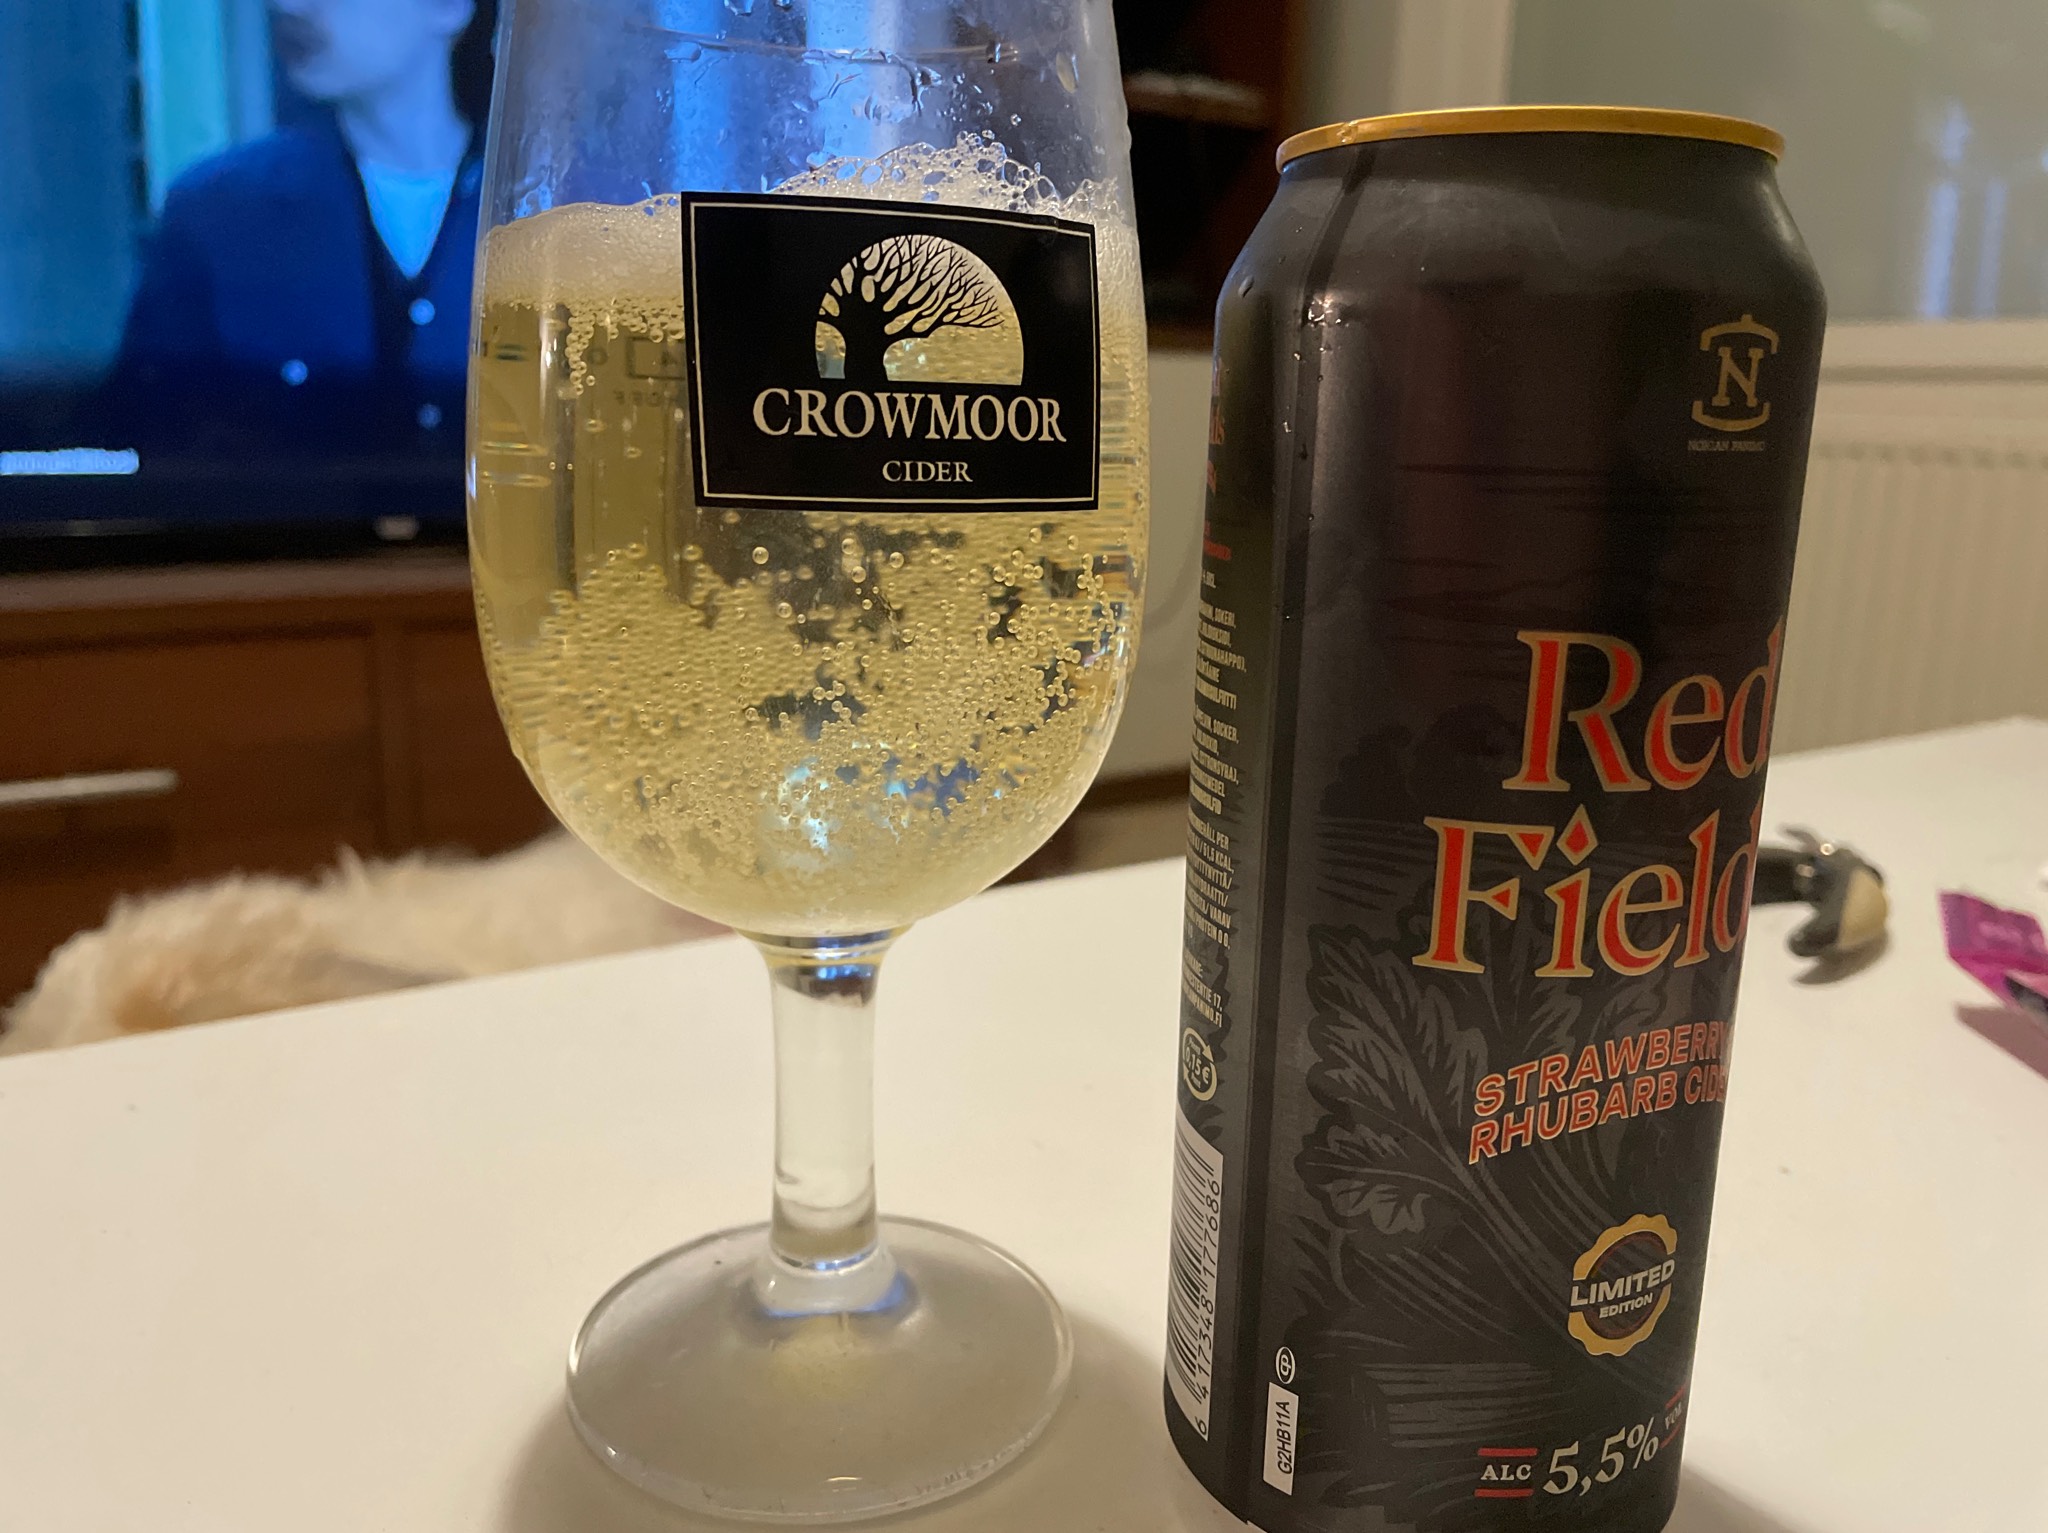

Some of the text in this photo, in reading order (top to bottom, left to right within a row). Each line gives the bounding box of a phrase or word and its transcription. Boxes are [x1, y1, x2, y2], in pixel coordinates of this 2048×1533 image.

[753, 388, 1067, 442] CROWMOOR
[882, 460, 973, 483] CIDER
[1502, 615, 1784, 793] Red
[1412, 804, 1762, 978] Field
[1468, 1070, 1678, 1165] RHUBARB
[1203, 1178, 1221, 1279] 177686
[1570, 1259, 1676, 1307] LIMITED
[1599, 1293, 1653, 1319] EDITION
[1196, 1294, 1214, 1400] 417348
[1275, 1401, 1293, 1475] G2HB11A
[1480, 1464, 1532, 1482] ALC
[1543, 1416, 1660, 1497] 5,5%
